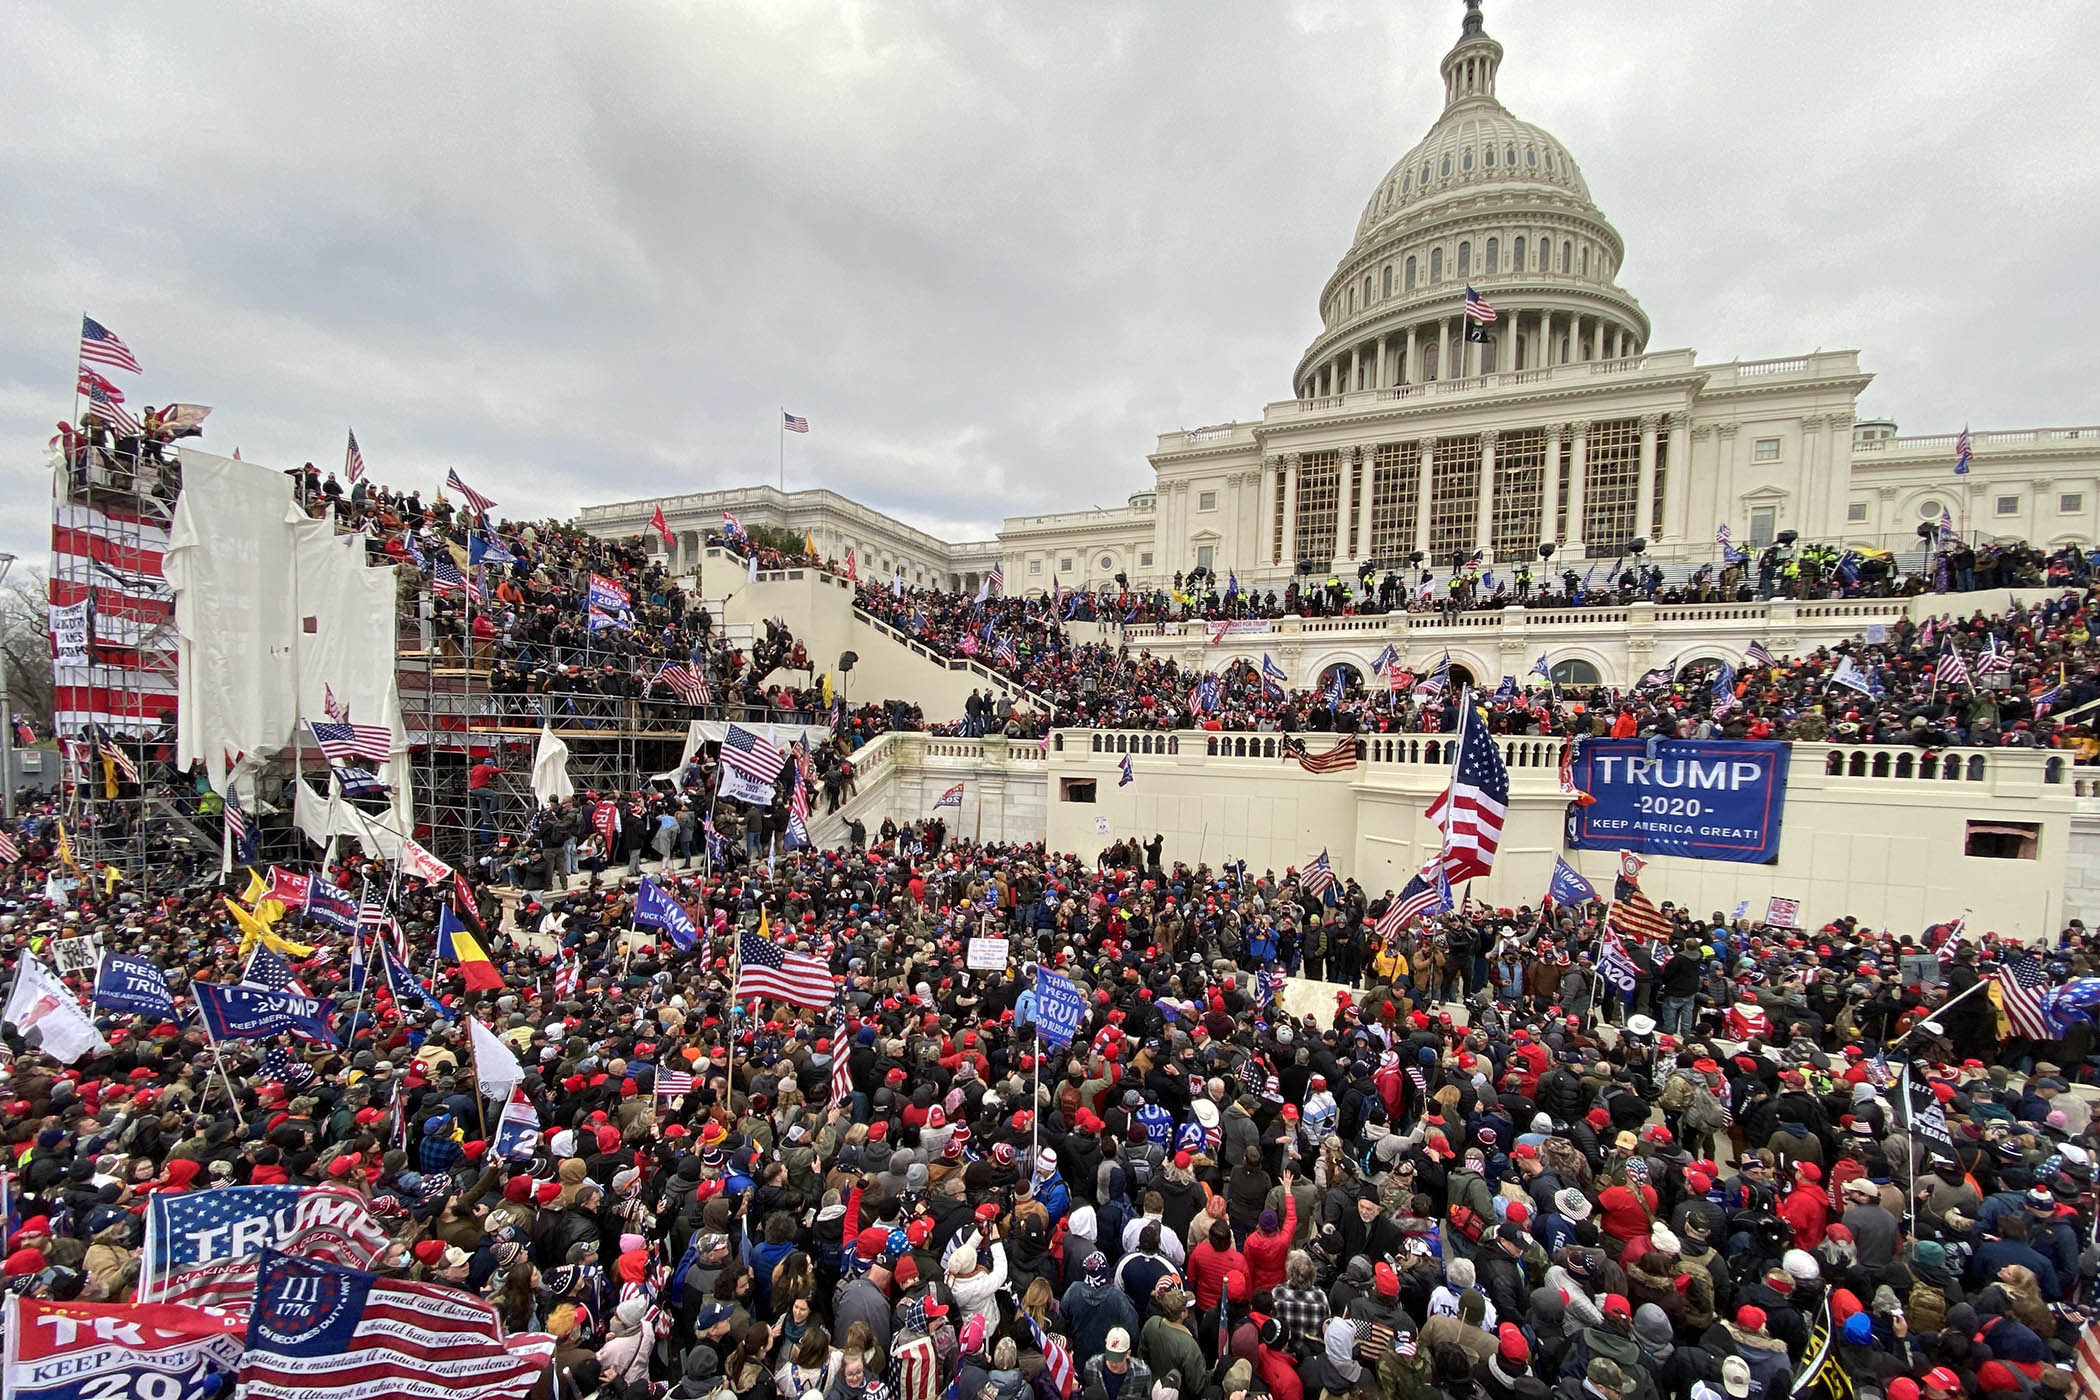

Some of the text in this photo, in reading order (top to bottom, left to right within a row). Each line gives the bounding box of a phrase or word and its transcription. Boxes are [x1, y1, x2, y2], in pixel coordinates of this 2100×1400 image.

[1595, 756, 1762, 791] TRUMP
[1592, 819, 1760, 840] KEEP AMERICA GREAT!
[53, 937, 90, 951] FUCK
[64, 948, 88, 958] THE
[63, 955, 95, 970] NWO
[230, 1020, 257, 1031] KEEP
[185, 1197, 385, 1263] TRUMP
[335, 1240, 363, 1266] AGAIN!
[175, 1264, 241, 1284] MAKING
[277, 1276, 321, 1303] III
[275, 1302, 312, 1317] 1776
[374, 1293, 415, 1307] armed
[416, 1299, 443, 1313] and
[270, 1326, 321, 1345] BECOMES
[319, 1303, 345, 1330] DUTY
[405, 1327, 434, 1346] have
[32, 1351, 113, 1382] KEEP
[289, 1357, 303, 1371] to
[306, 1355, 364, 1372] maintain
[379, 1350, 416, 1367] status
[418, 1363, 434, 1374] of
[434, 1356, 515, 1376] independence
[354, 1387, 367, 1398] to
[369, 1380, 404, 1395] abuse
[406, 1379, 438, 1396] them,
